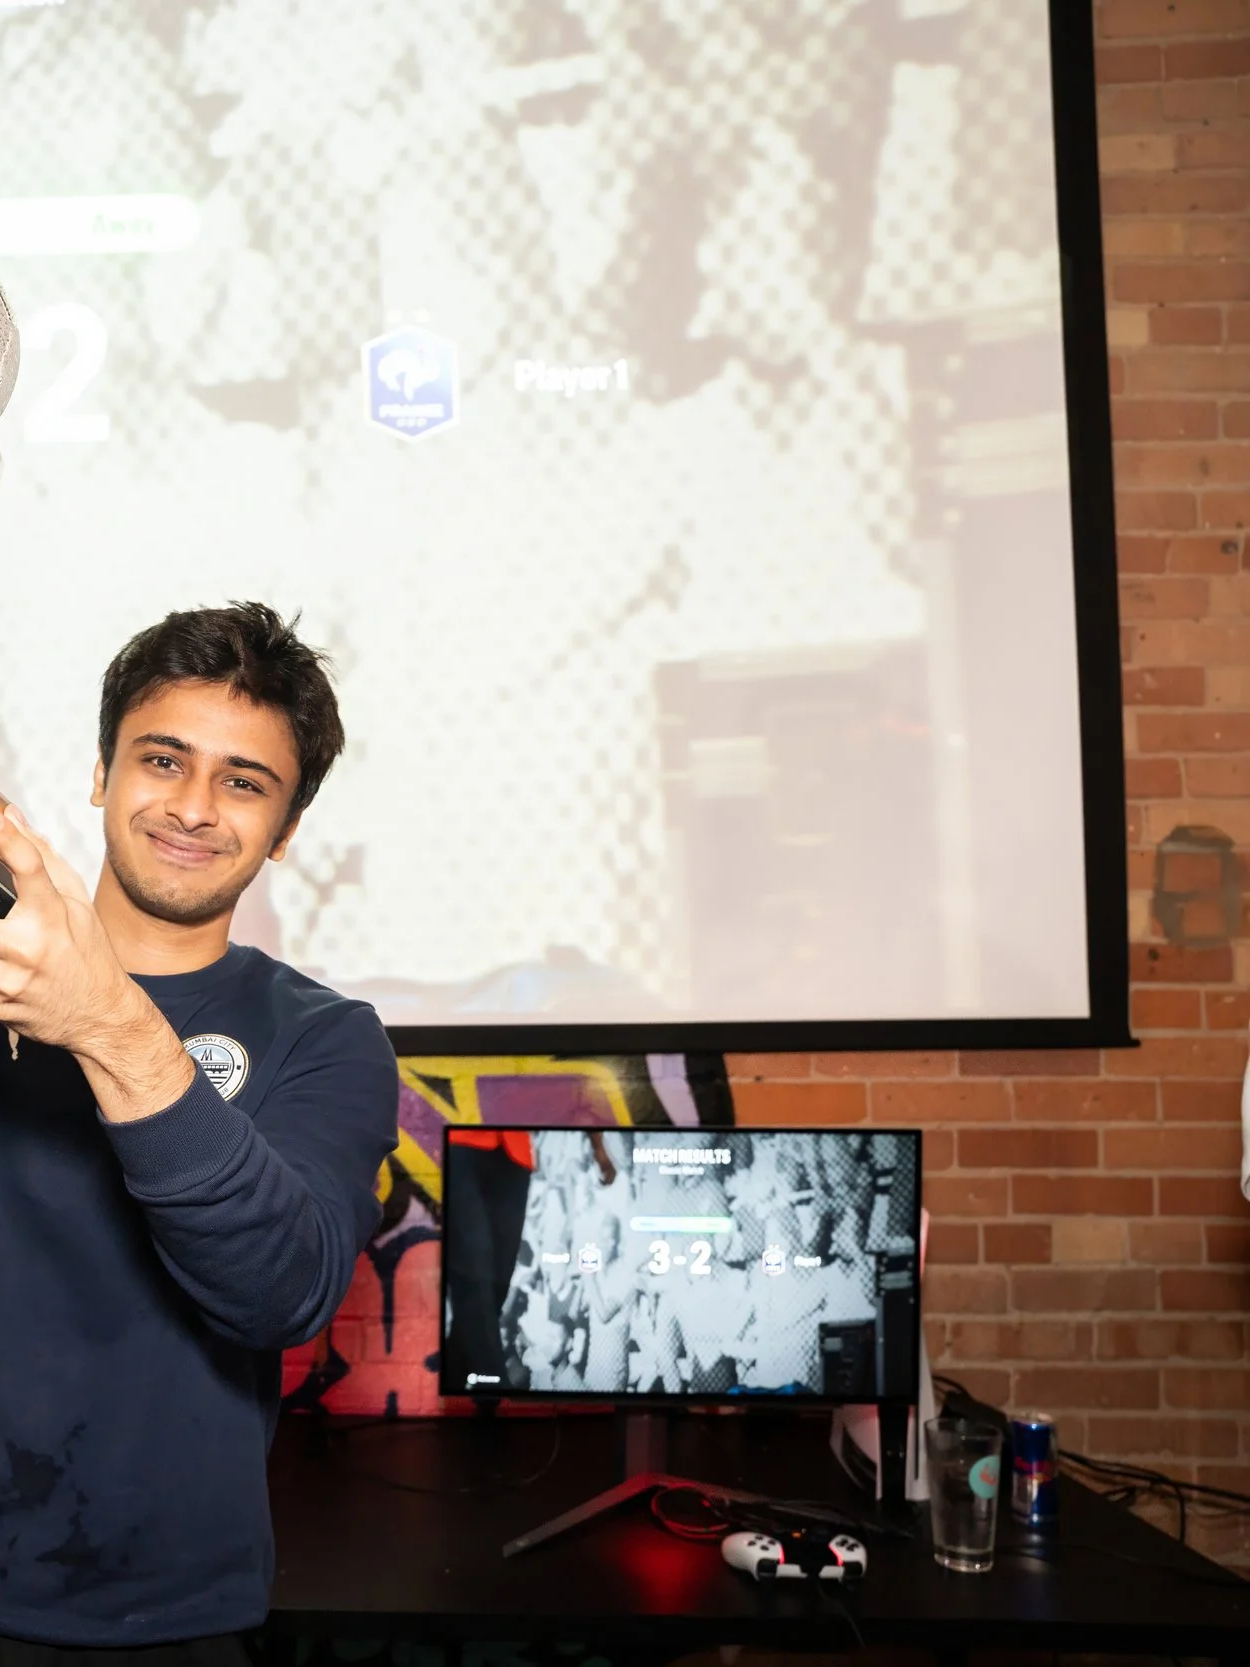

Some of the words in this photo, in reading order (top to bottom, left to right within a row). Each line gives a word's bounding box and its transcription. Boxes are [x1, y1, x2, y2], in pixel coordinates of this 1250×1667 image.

[21, 301, 110, 444] 2
[219, 1039, 236, 1050] CITY
[633, 1148, 678, 1164] MATCH
